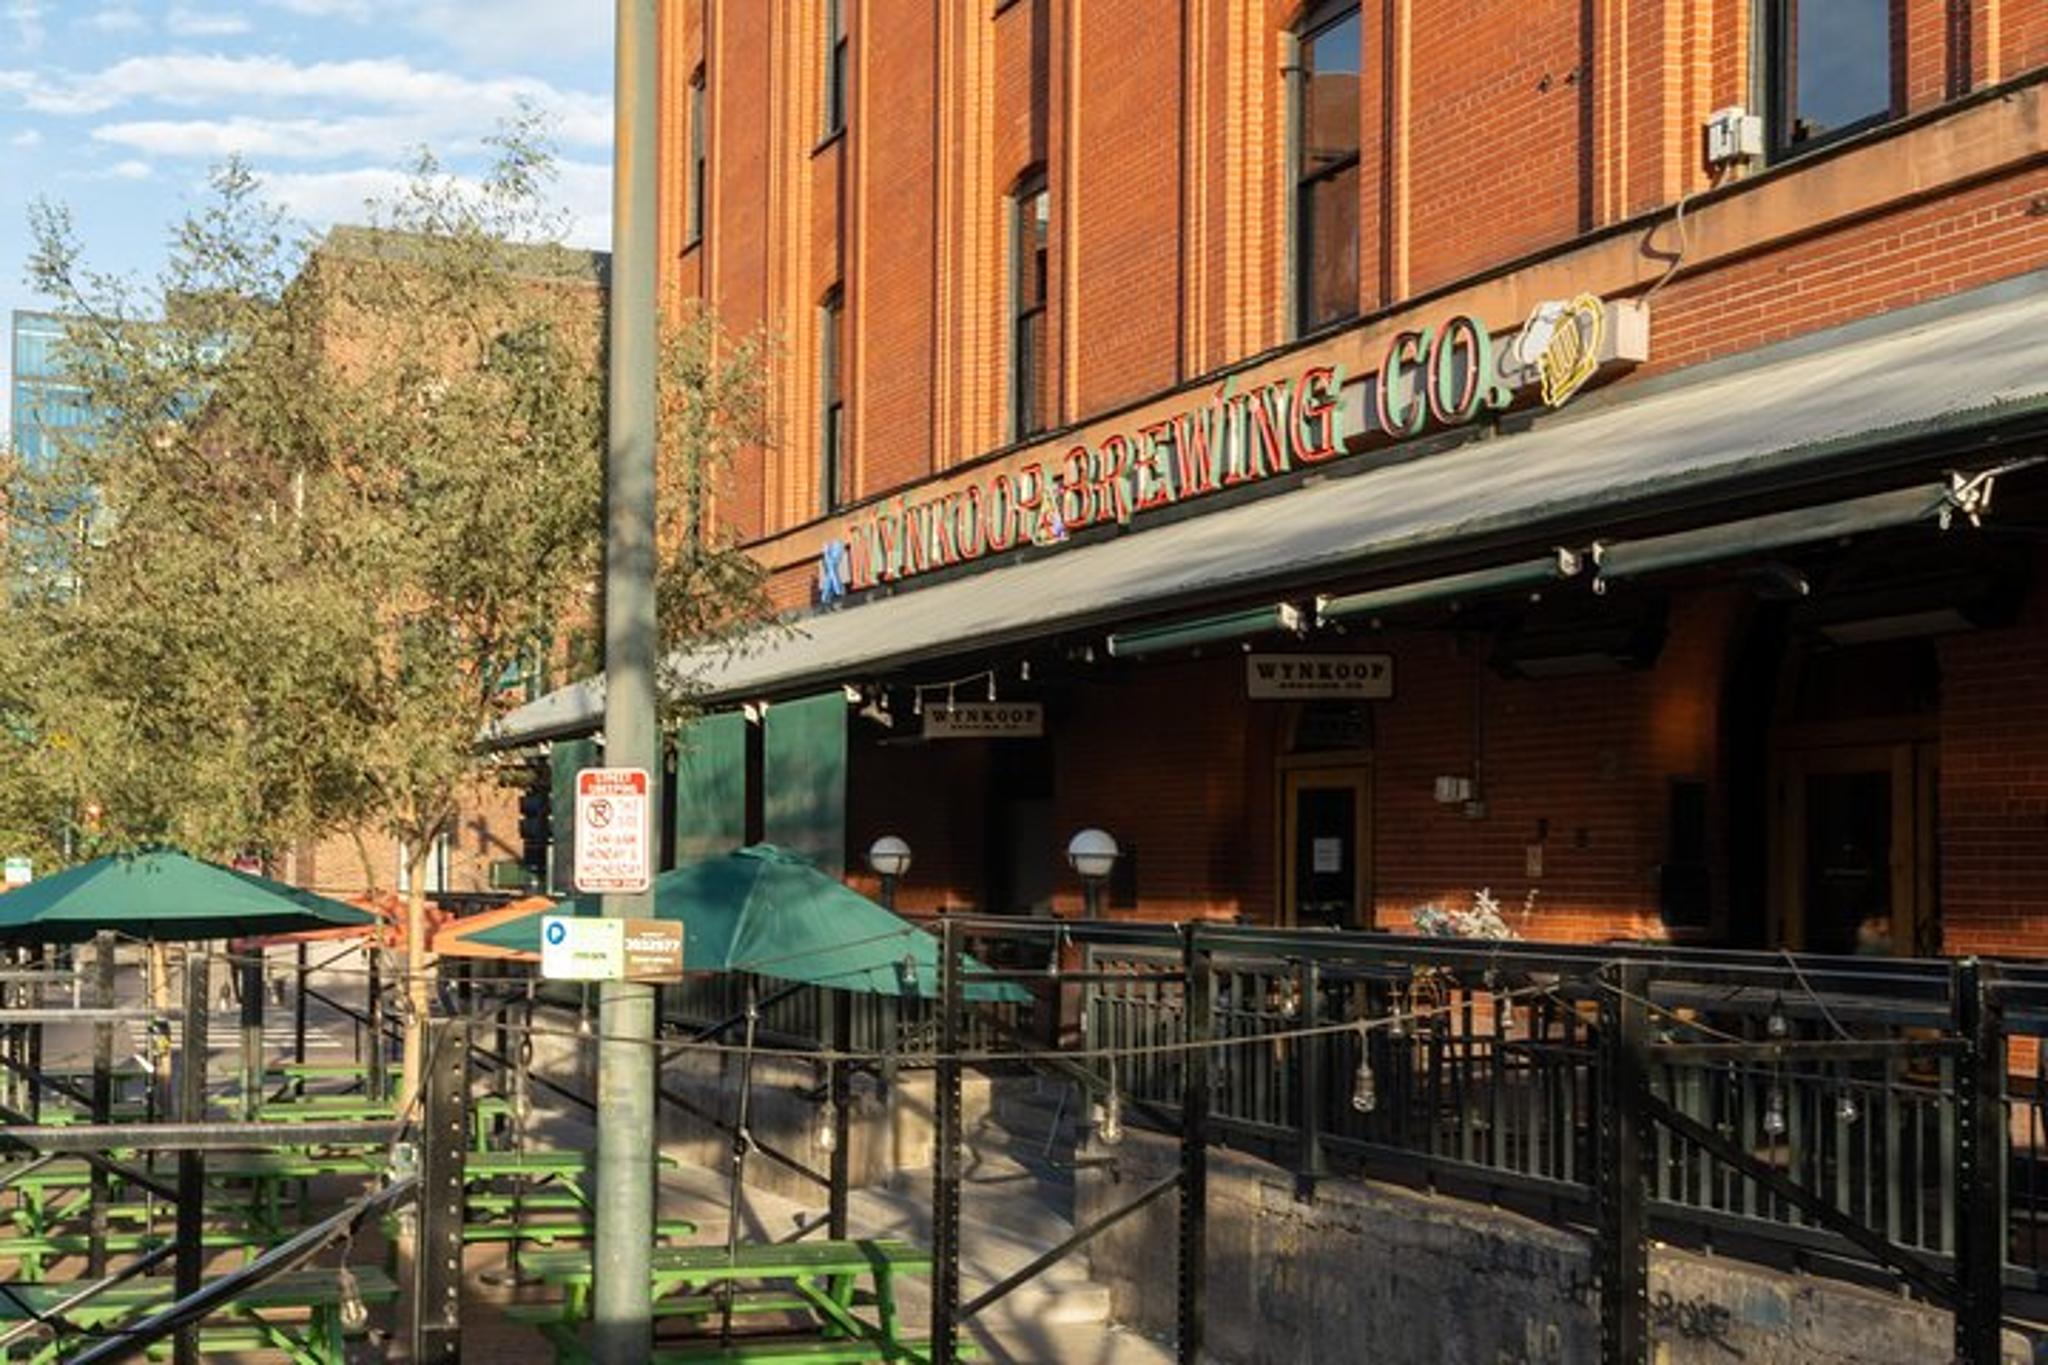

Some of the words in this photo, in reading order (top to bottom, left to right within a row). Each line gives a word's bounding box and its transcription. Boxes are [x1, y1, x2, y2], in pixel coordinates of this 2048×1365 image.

[847, 462, 1042, 590] WYNKOOP
[1061, 364, 1347, 528] BREWING
[1377, 314, 1513, 439] CO.
[1256, 661, 1385, 680] WYNKOOP
[932, 708, 1037, 723] WYNKOOP
